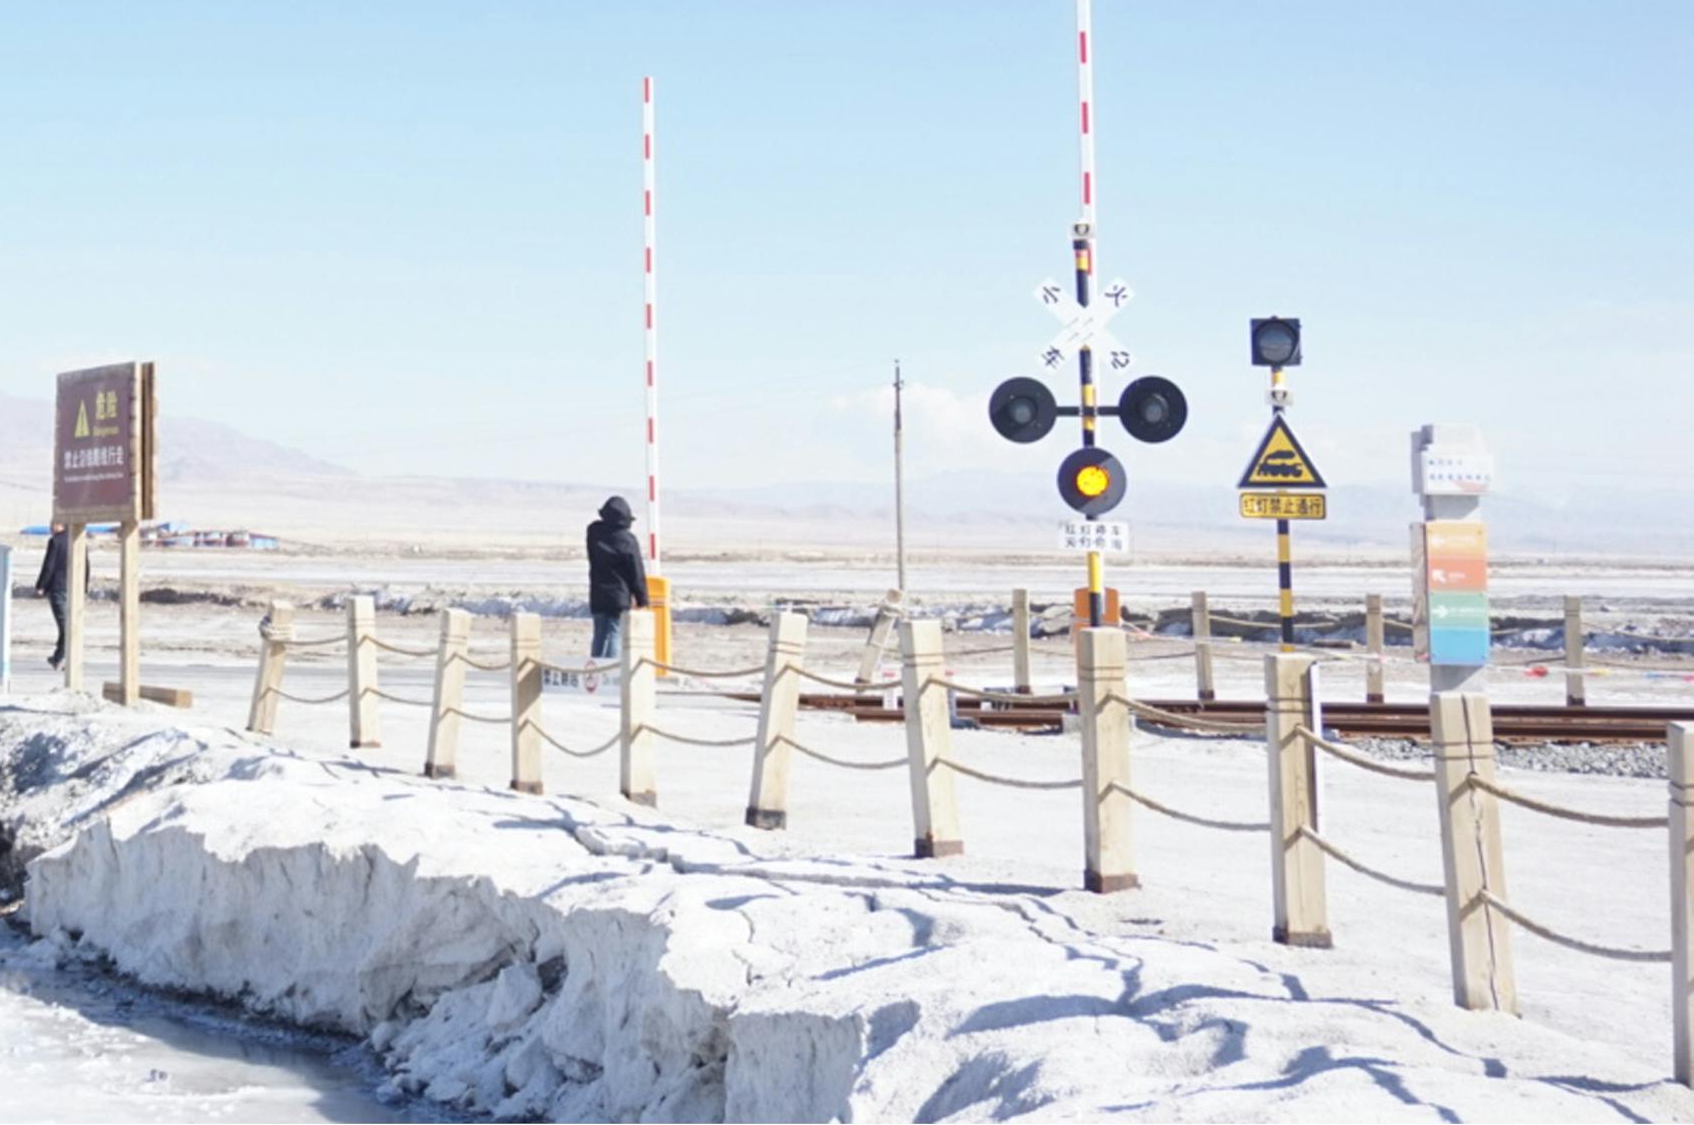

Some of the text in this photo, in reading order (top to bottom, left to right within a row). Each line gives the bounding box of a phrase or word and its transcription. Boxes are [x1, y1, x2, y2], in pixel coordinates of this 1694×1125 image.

[1040, 283, 1129, 370] 火 车
[1042, 285, 1131, 370] 小 心
[95, 390, 118, 420] 危险
[1243, 496, 1321, 515] 红灯禁止通行
